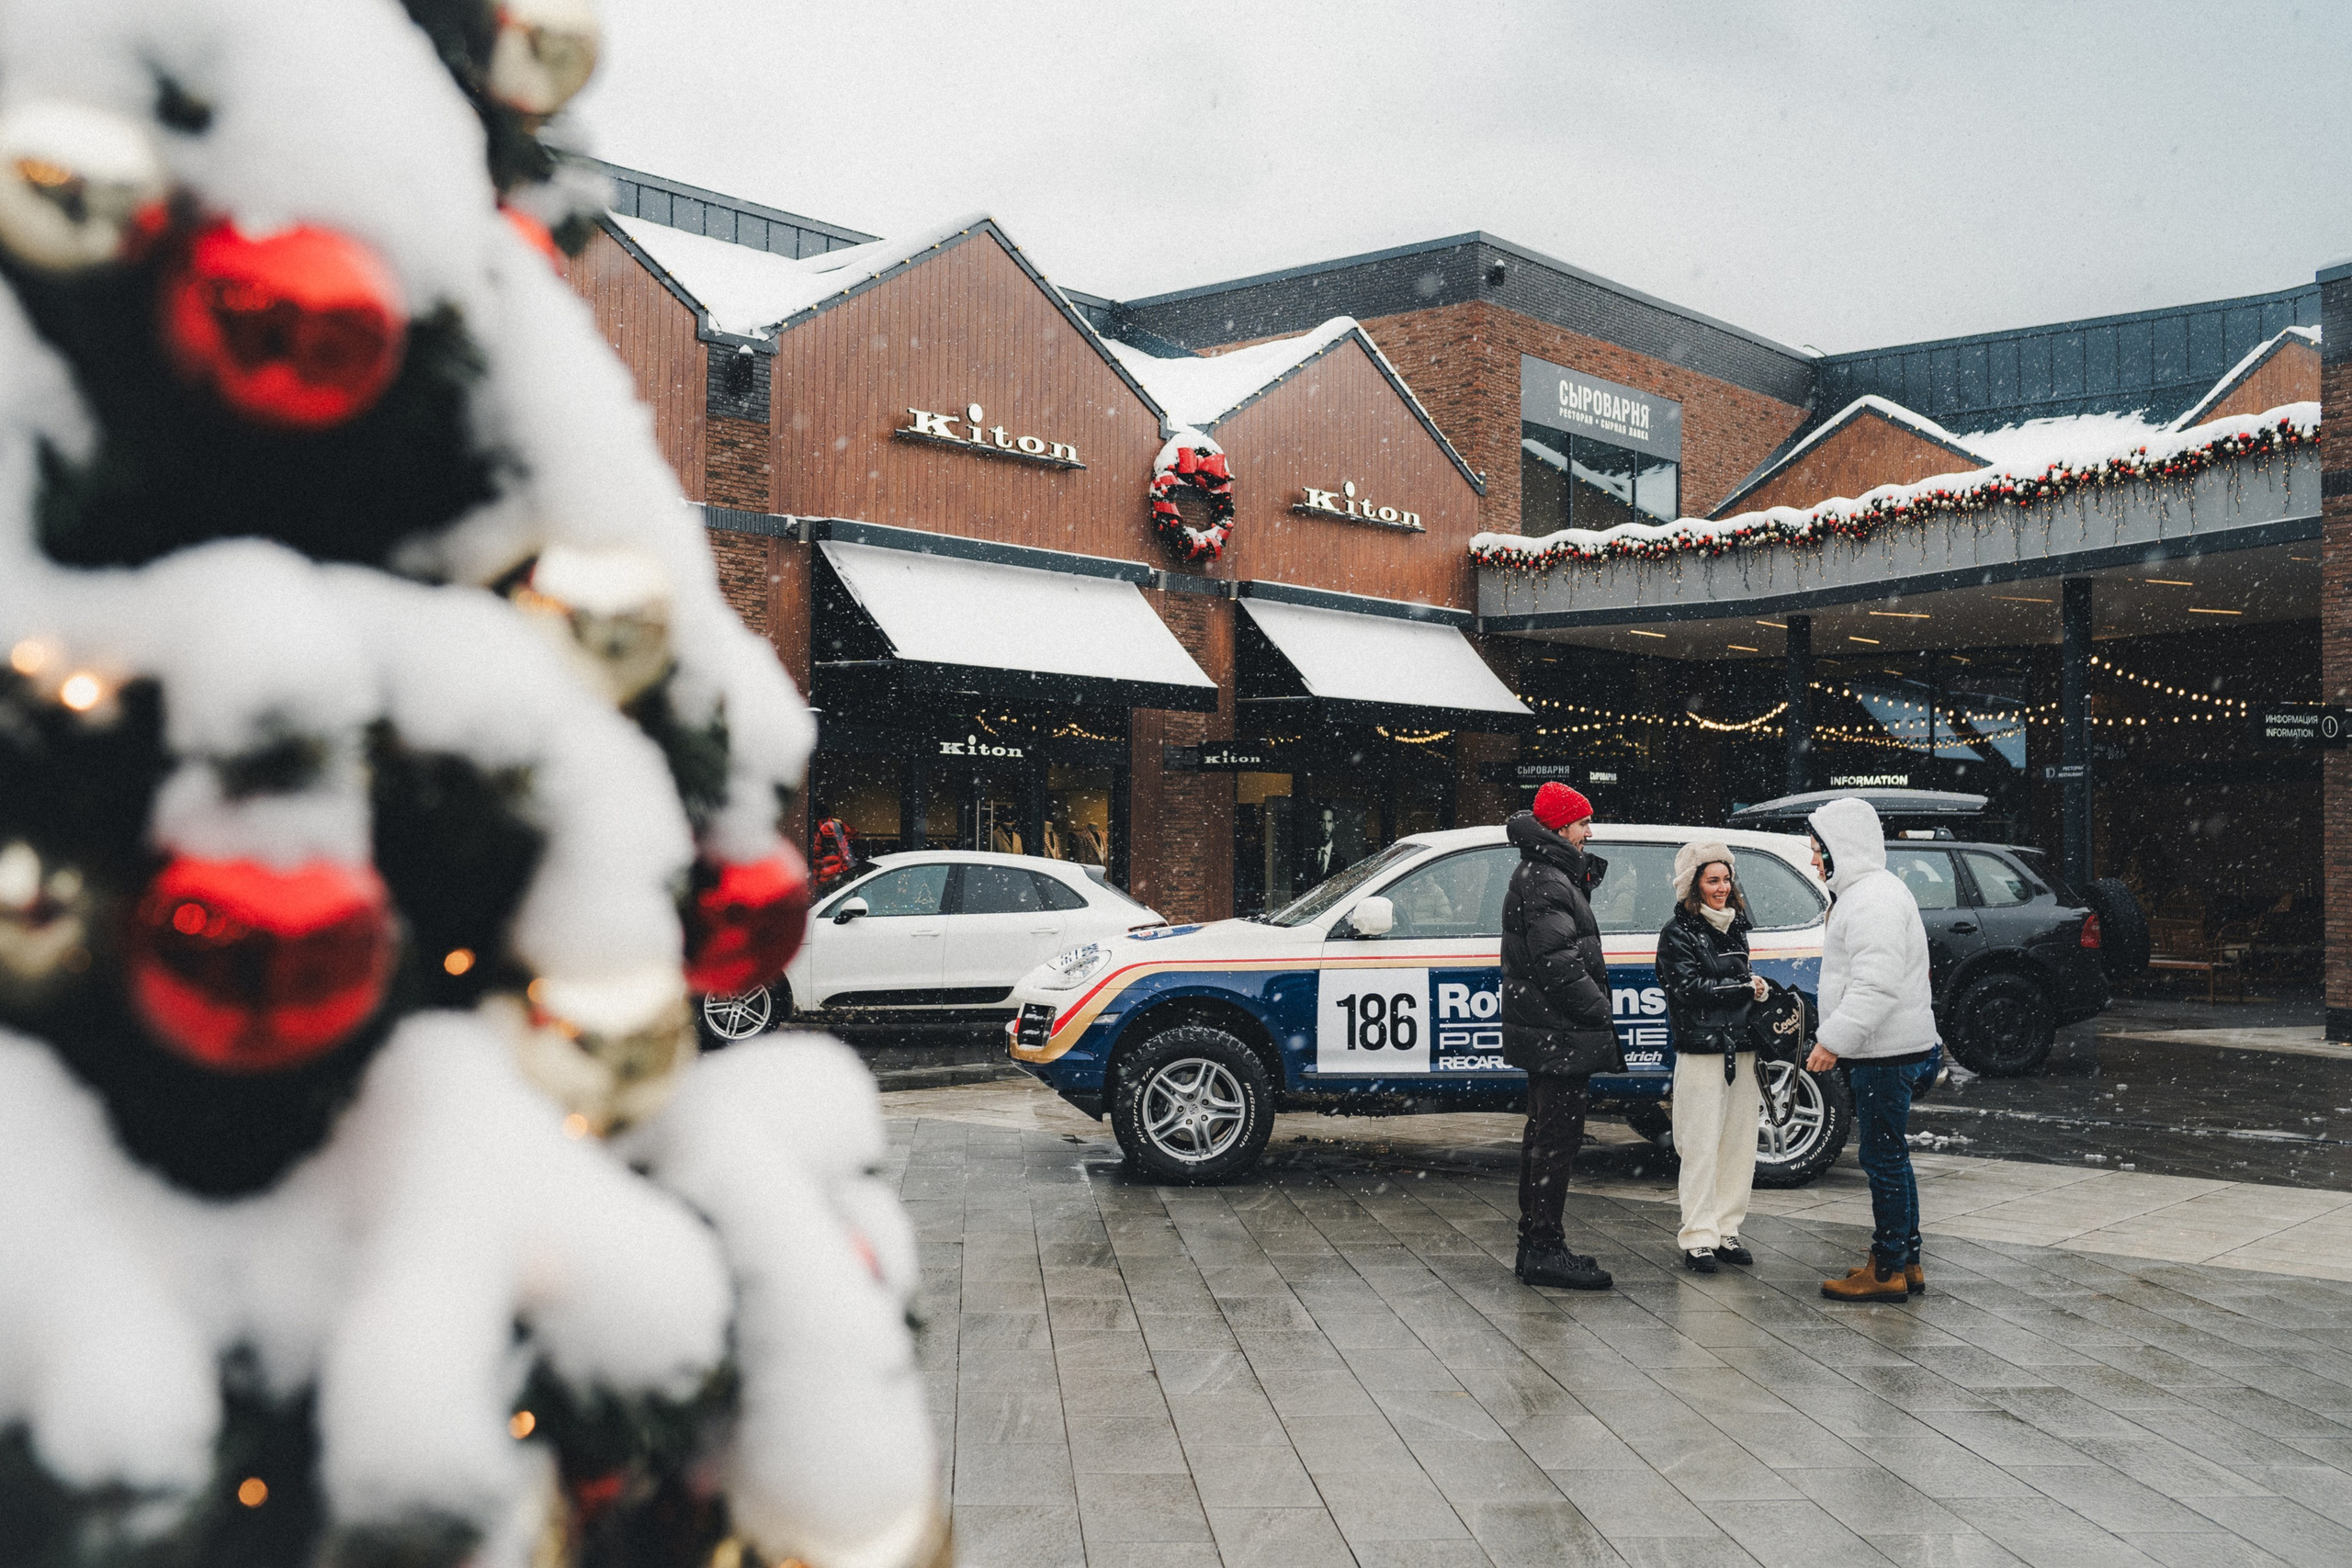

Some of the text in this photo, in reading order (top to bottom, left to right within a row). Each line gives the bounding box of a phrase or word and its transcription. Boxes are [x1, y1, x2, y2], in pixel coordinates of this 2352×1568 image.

[1559, 379, 1649, 429] СЫРОВАРНЯ
[907, 402, 1080, 461] Kiton
[1559, 407, 1649, 441] РЕСТОРАН СЫРНАЯ ЛАВКА
[1303, 480, 1421, 526] Kiton
[2266, 715, 2318, 725] ИНФОРМАЦИЯ
[2266, 728, 2314, 738] INFORMATION
[939, 735, 1023, 758] Kiton
[1204, 750, 1261, 764] Kiton
[1517, 765, 1570, 774] СЫРОВАРНЯ
[1830, 774, 1908, 785] INFORMATION
[1439, 983, 1667, 1019] Rons
[1336, 993, 1418, 1051] 186
[1790, 1161, 1806, 1170] T/A
